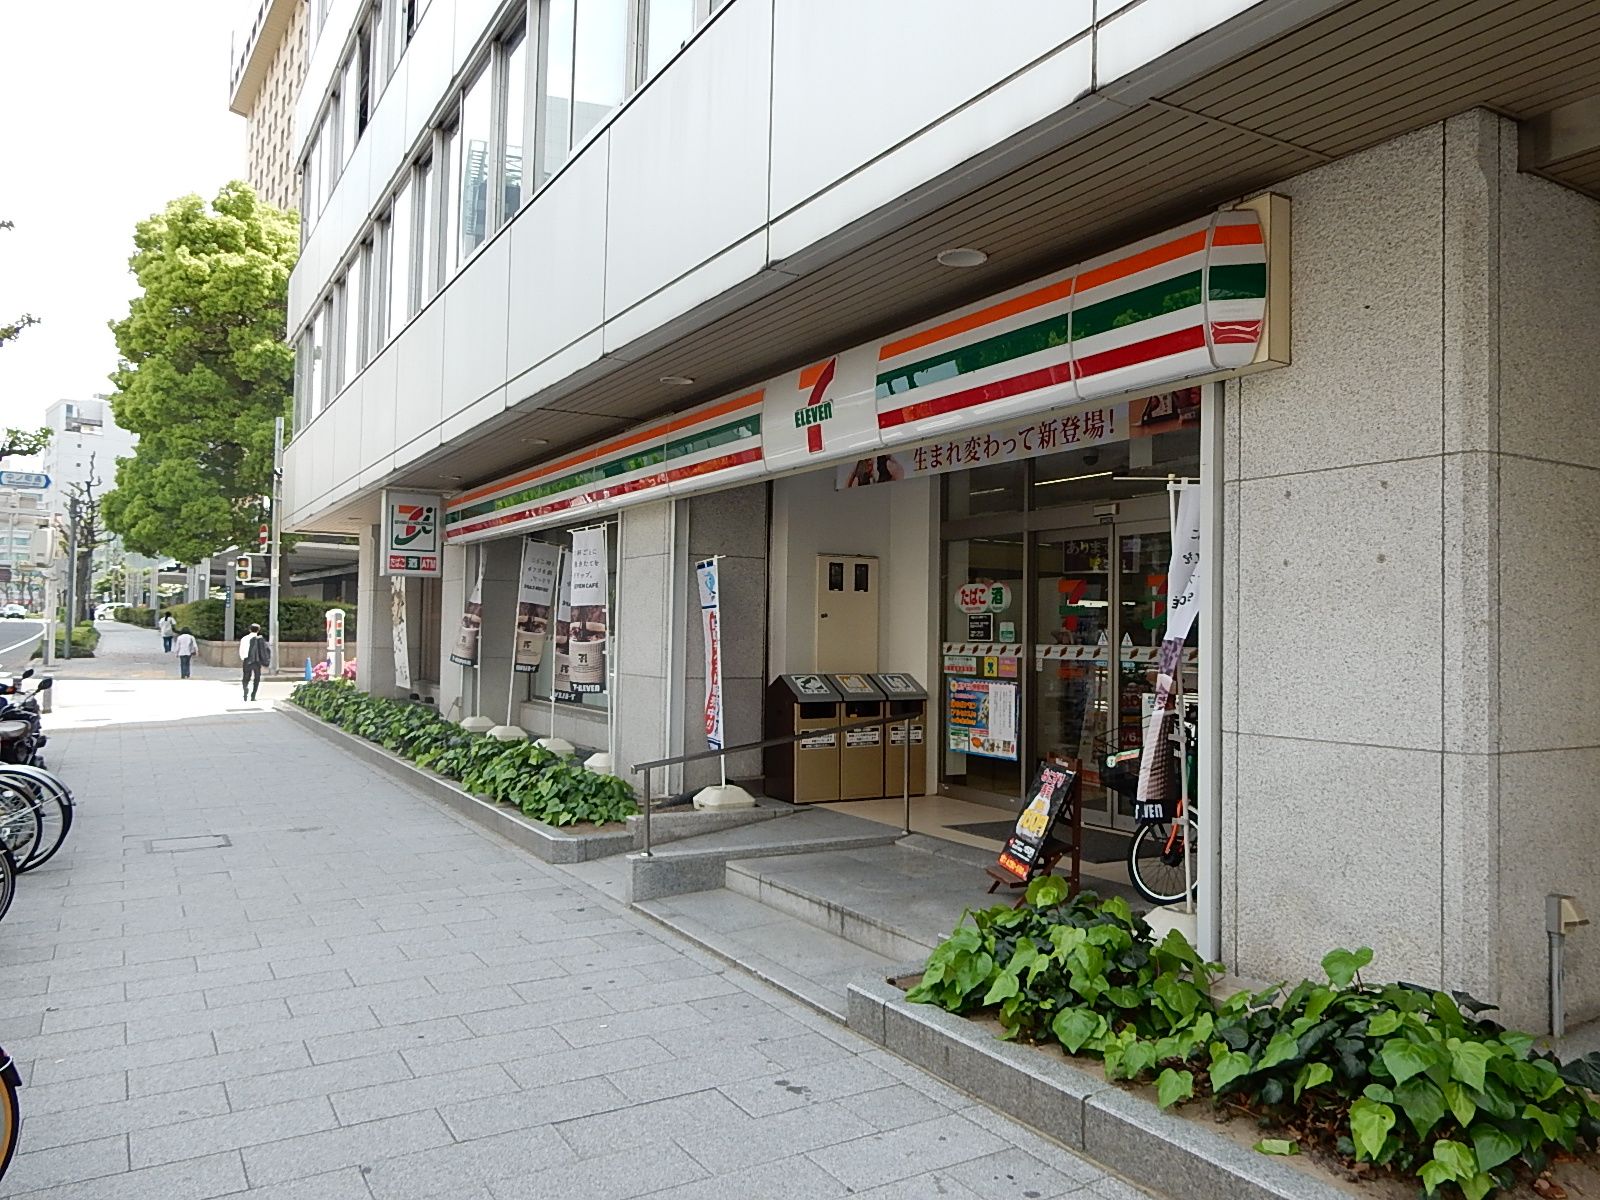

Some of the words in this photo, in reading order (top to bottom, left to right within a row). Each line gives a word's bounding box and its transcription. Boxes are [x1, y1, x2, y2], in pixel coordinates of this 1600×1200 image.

[798, 356, 837, 453] 7
[913, 408, 1116, 473] 生まれ変わって新登場!
[421, 558, 436, 569] ATM
[960, 587, 987, 606] たばこ
[991, 586, 1004, 605] 酒
